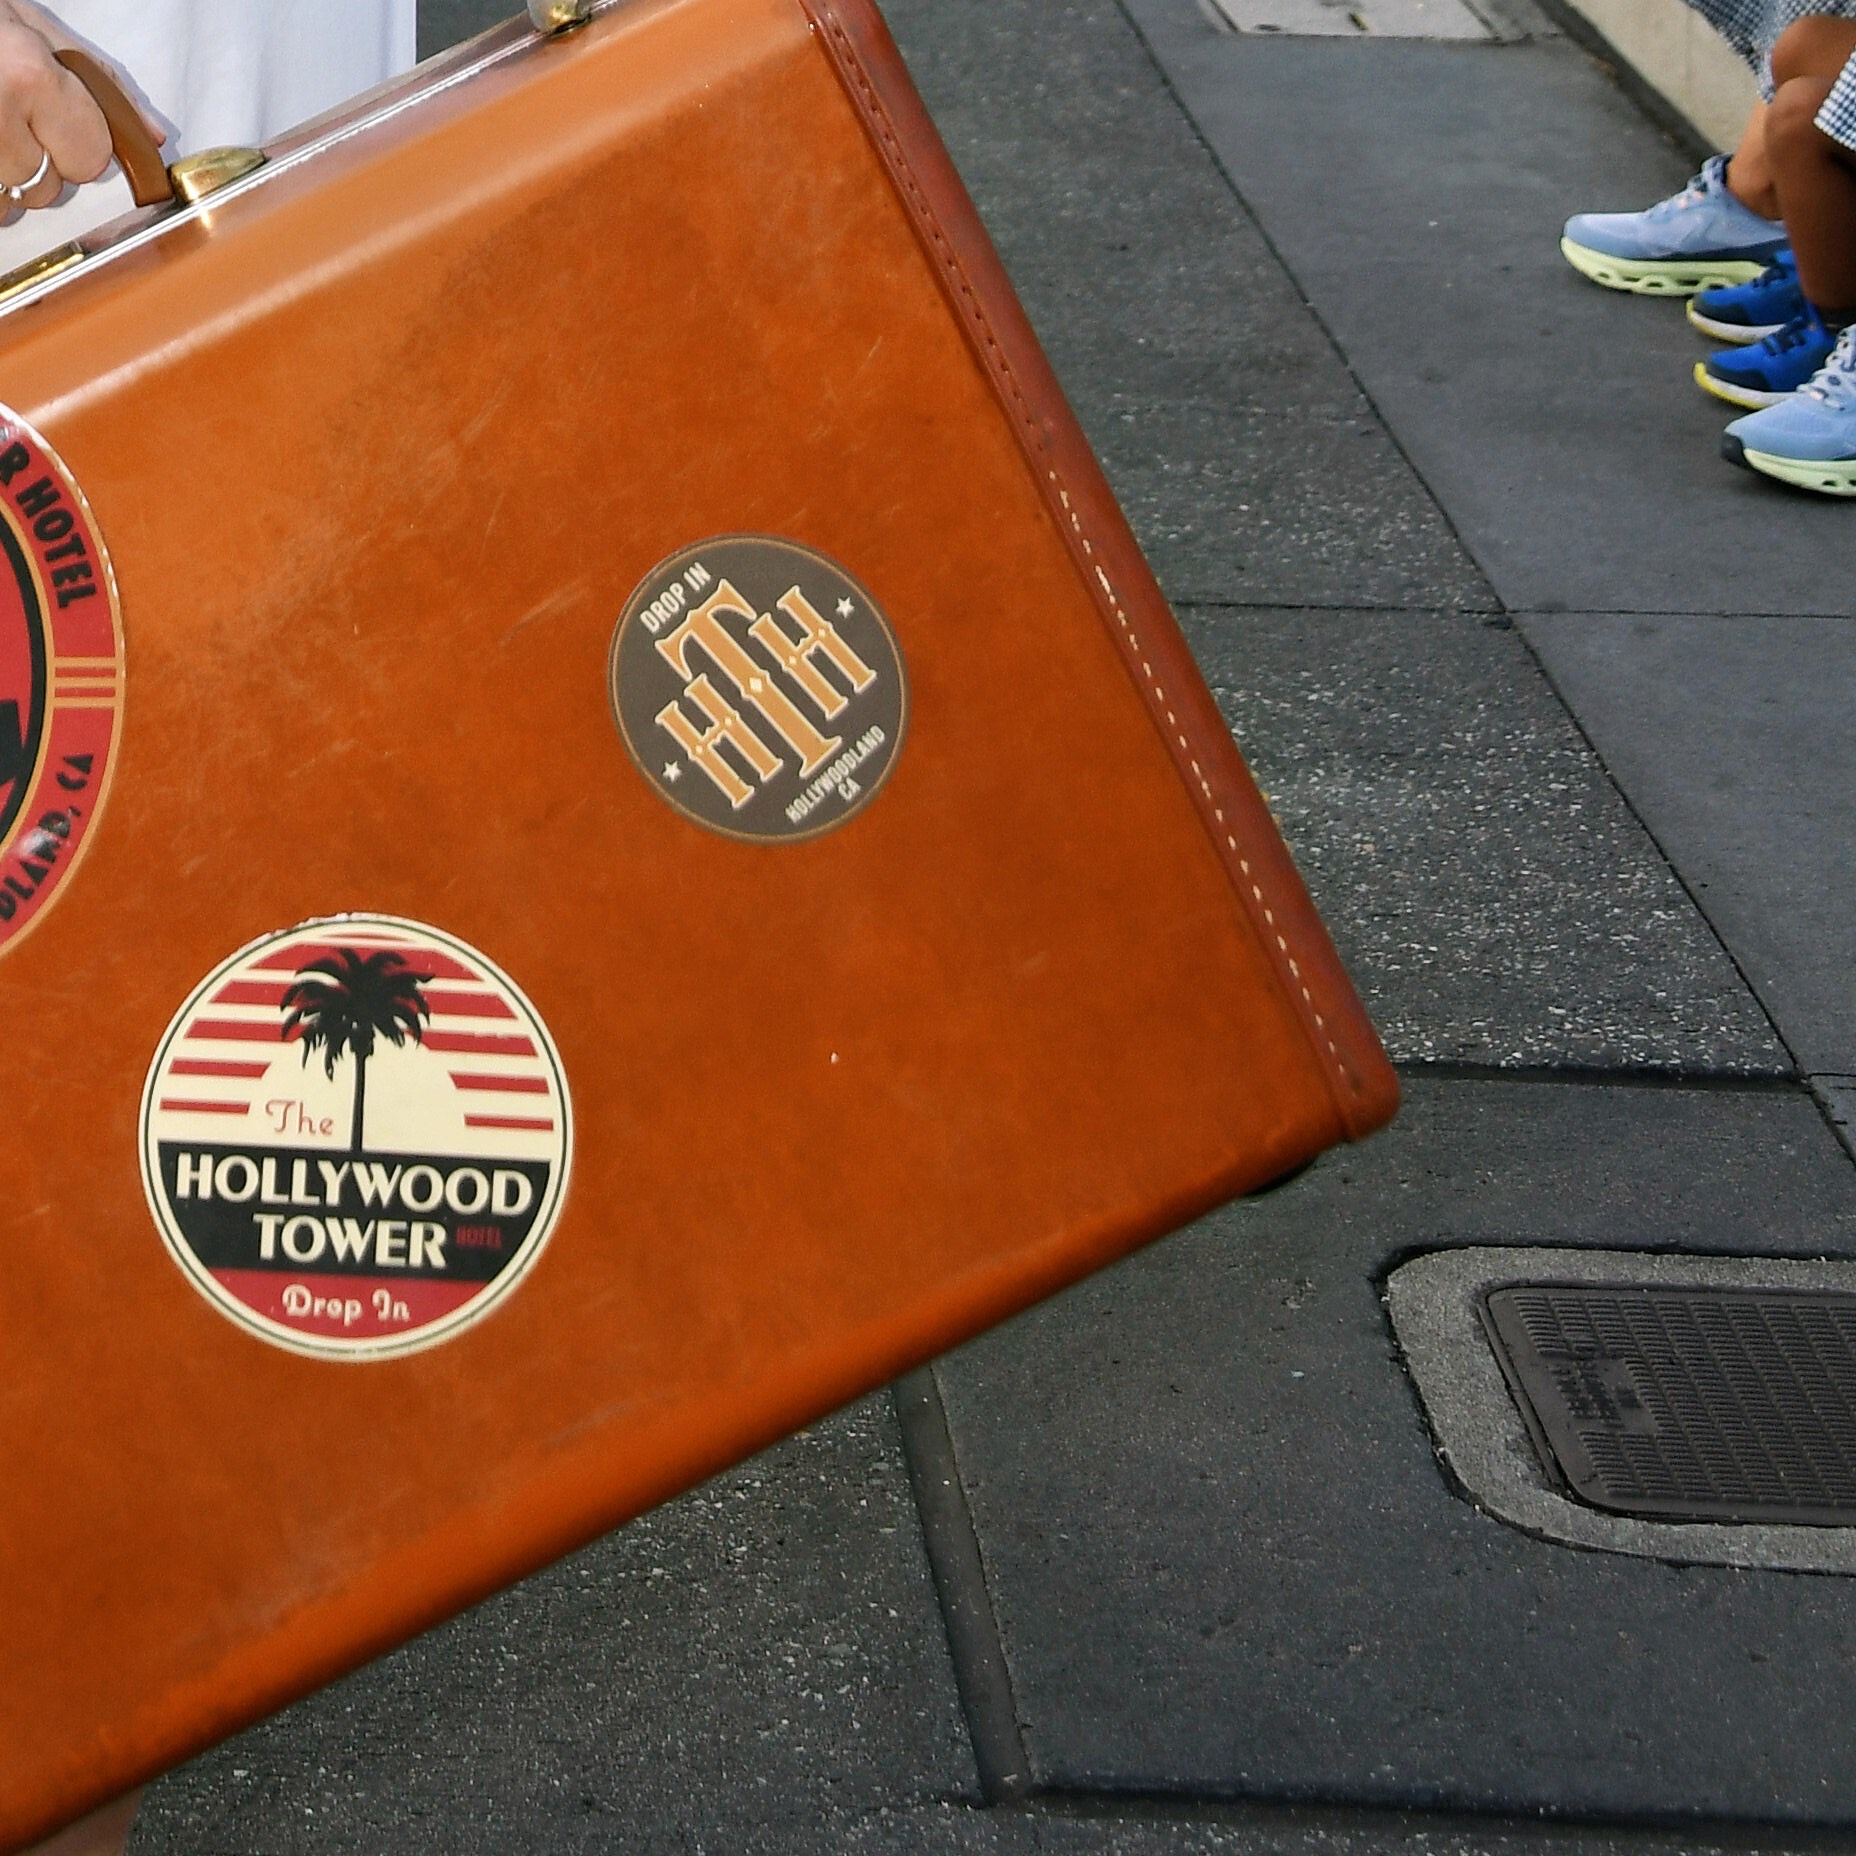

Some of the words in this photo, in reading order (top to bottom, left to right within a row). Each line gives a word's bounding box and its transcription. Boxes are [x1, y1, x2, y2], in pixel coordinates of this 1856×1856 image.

[15, 477, 98, 609] HOTEL
[640, 583, 687, 634] DROP
[683, 561, 712, 593] IN
[56, 753, 94, 790] CA
[784, 724, 886, 824] HOLLYWOODLAND
[837, 777, 862, 802] CA
[265, 1099, 335, 1136] The
[176, 1150, 534, 1217] HOLLYWOOD
[252, 1213, 448, 1269] TOWER
[281, 1284, 363, 1327] Drop
[372, 1288, 411, 1322] In
